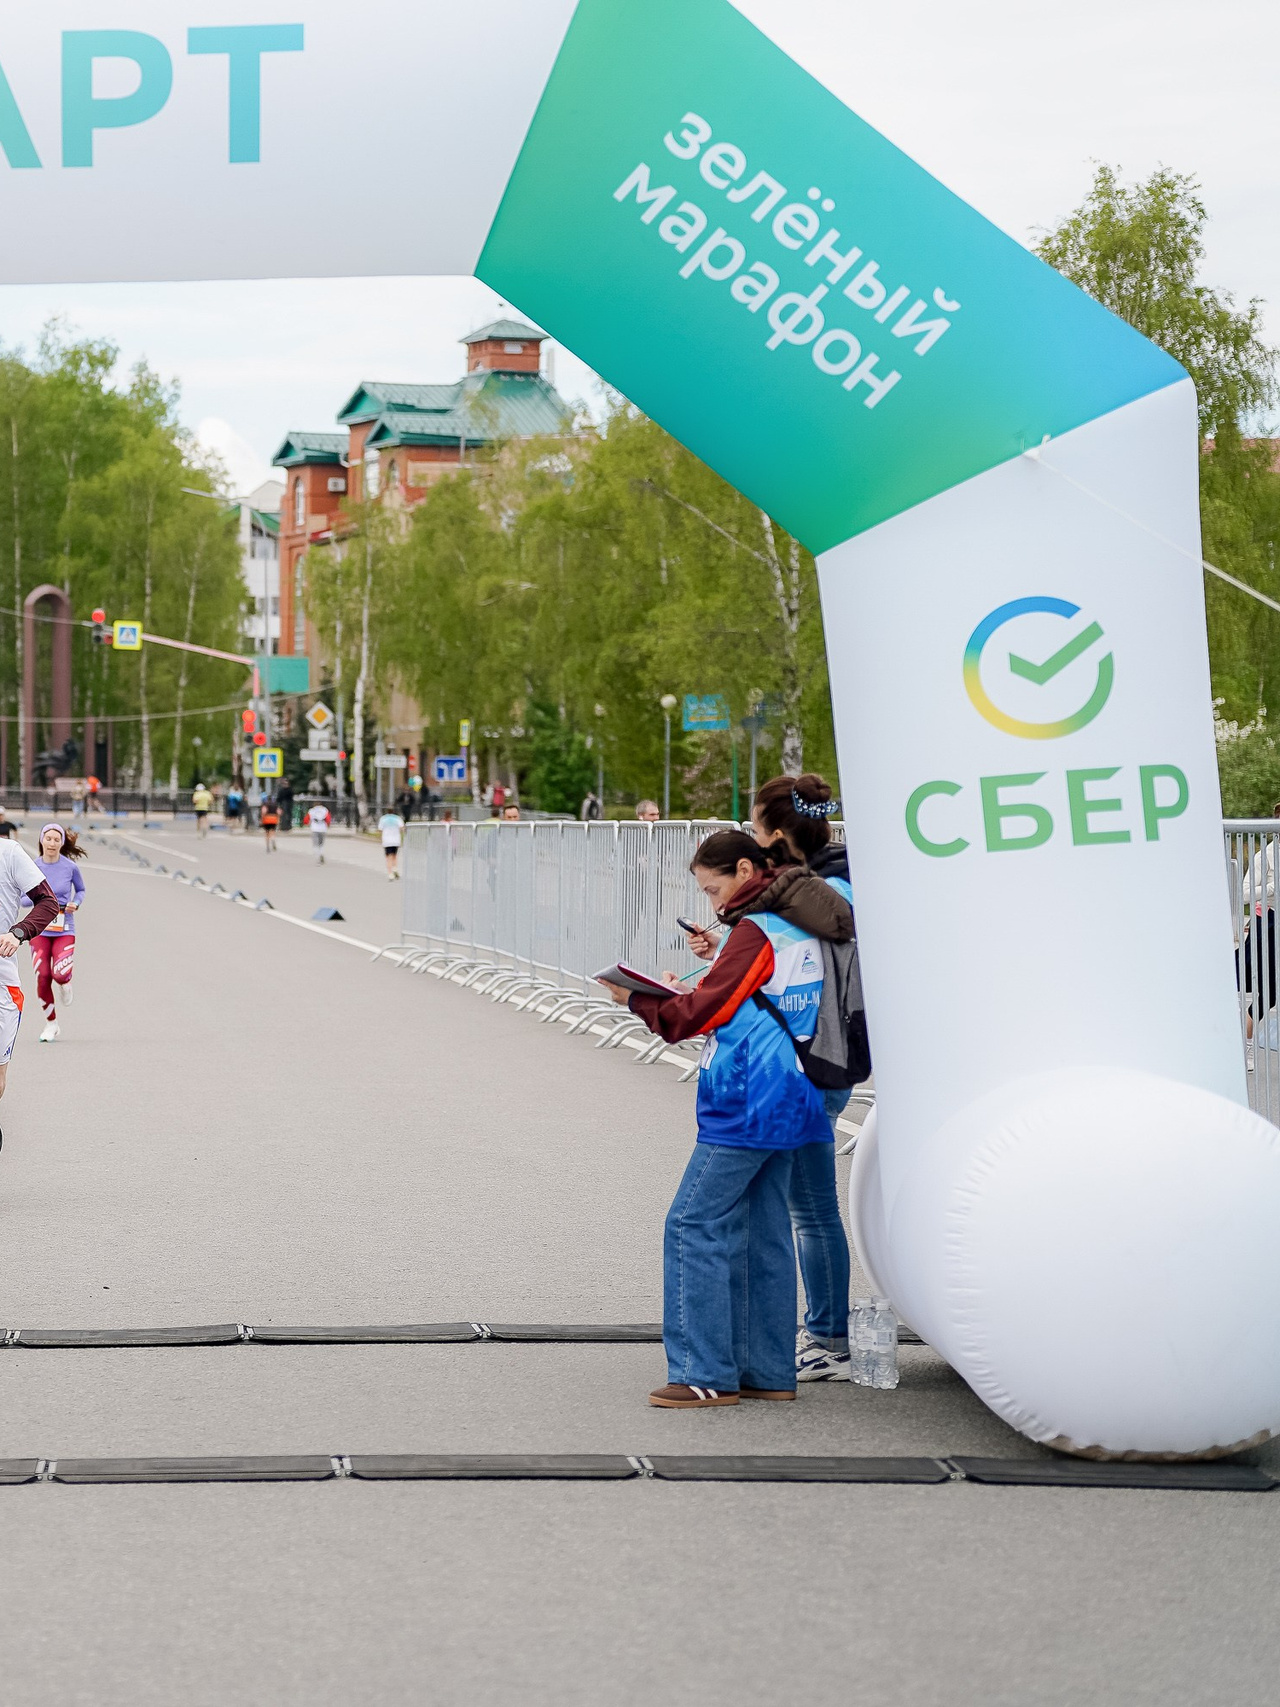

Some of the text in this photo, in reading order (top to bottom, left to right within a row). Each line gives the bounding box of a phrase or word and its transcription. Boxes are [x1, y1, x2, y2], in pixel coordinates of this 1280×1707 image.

[613, 162, 903, 410] марафон
[663, 111, 962, 357] зелёный
[905, 764, 1190, 858] СБЕР
